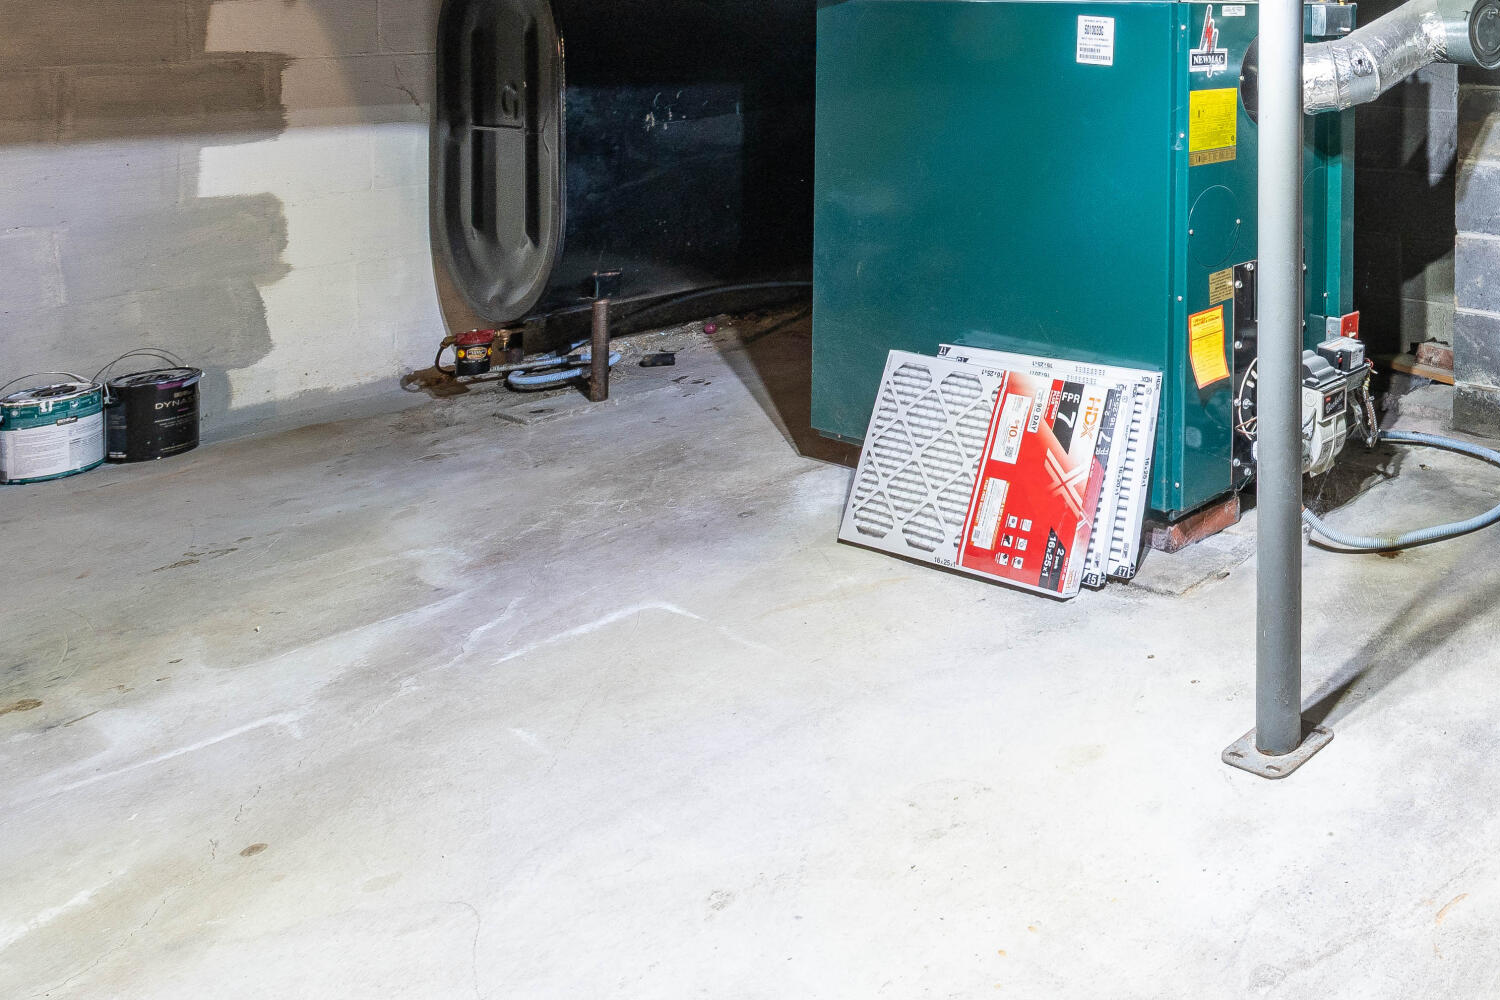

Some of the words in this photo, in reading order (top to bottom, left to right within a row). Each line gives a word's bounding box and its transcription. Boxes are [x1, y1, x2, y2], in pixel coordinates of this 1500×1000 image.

[1193, 54, 1224, 65] NEWMAC
[1061, 391, 1081, 404] FPR
[1031, 415, 1040, 431] DAY
[1057, 411, 1077, 429] 7
[1080, 397, 1101, 439] HDX
[1041, 536, 1057, 577] 16x25x1
[1056, 547, 1064, 556] 2
[934, 556, 956, 568] 16x25x1
